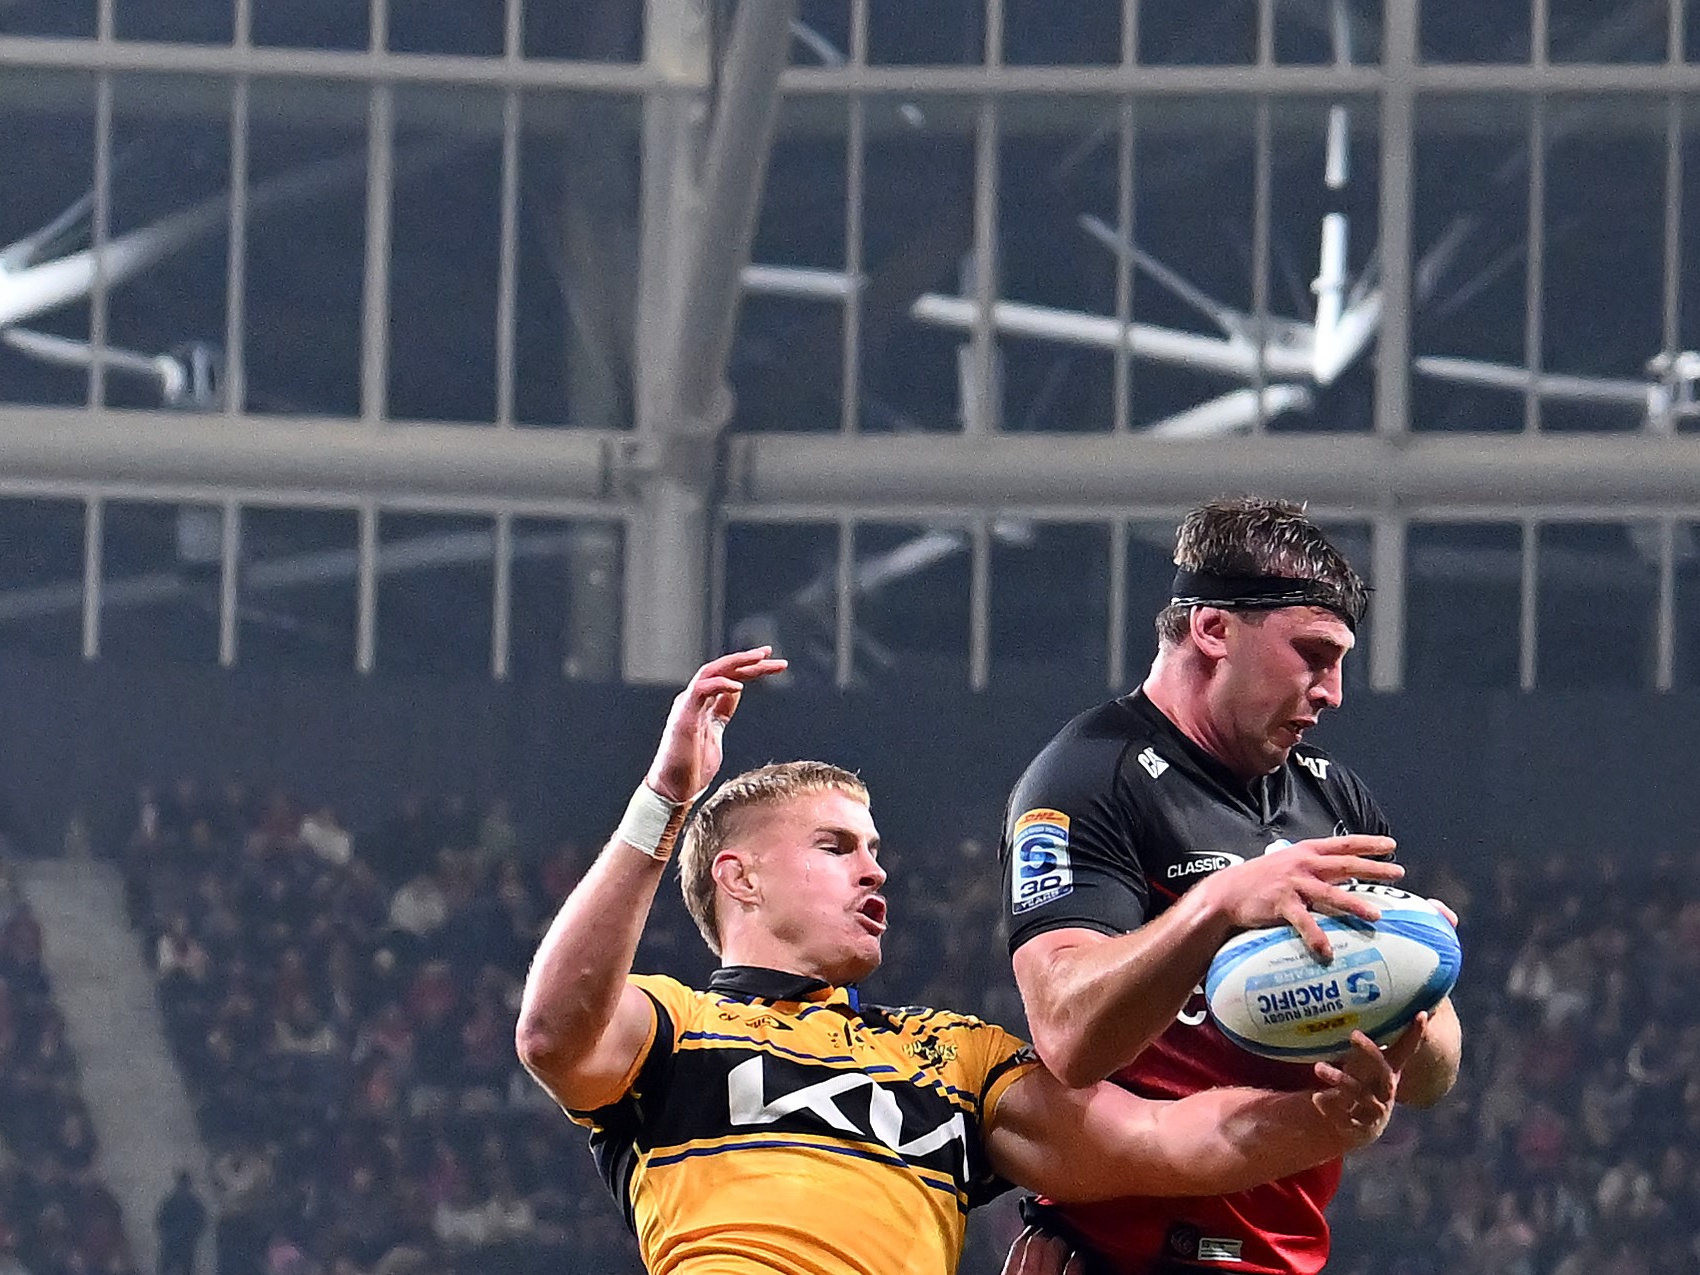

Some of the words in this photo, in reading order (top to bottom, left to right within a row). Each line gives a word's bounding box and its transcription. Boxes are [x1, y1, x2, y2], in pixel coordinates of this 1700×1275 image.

[1137, 748, 1170, 779] CA
[1167, 856, 1227, 879] CLASSIC
[1021, 876, 1062, 898] 30
[1020, 891, 1060, 910] YEARS
[1257, 980, 1341, 1014] PACIFIC
[1304, 999, 1345, 1017] SUPER
[1263, 1009, 1302, 1026] RUGBY
